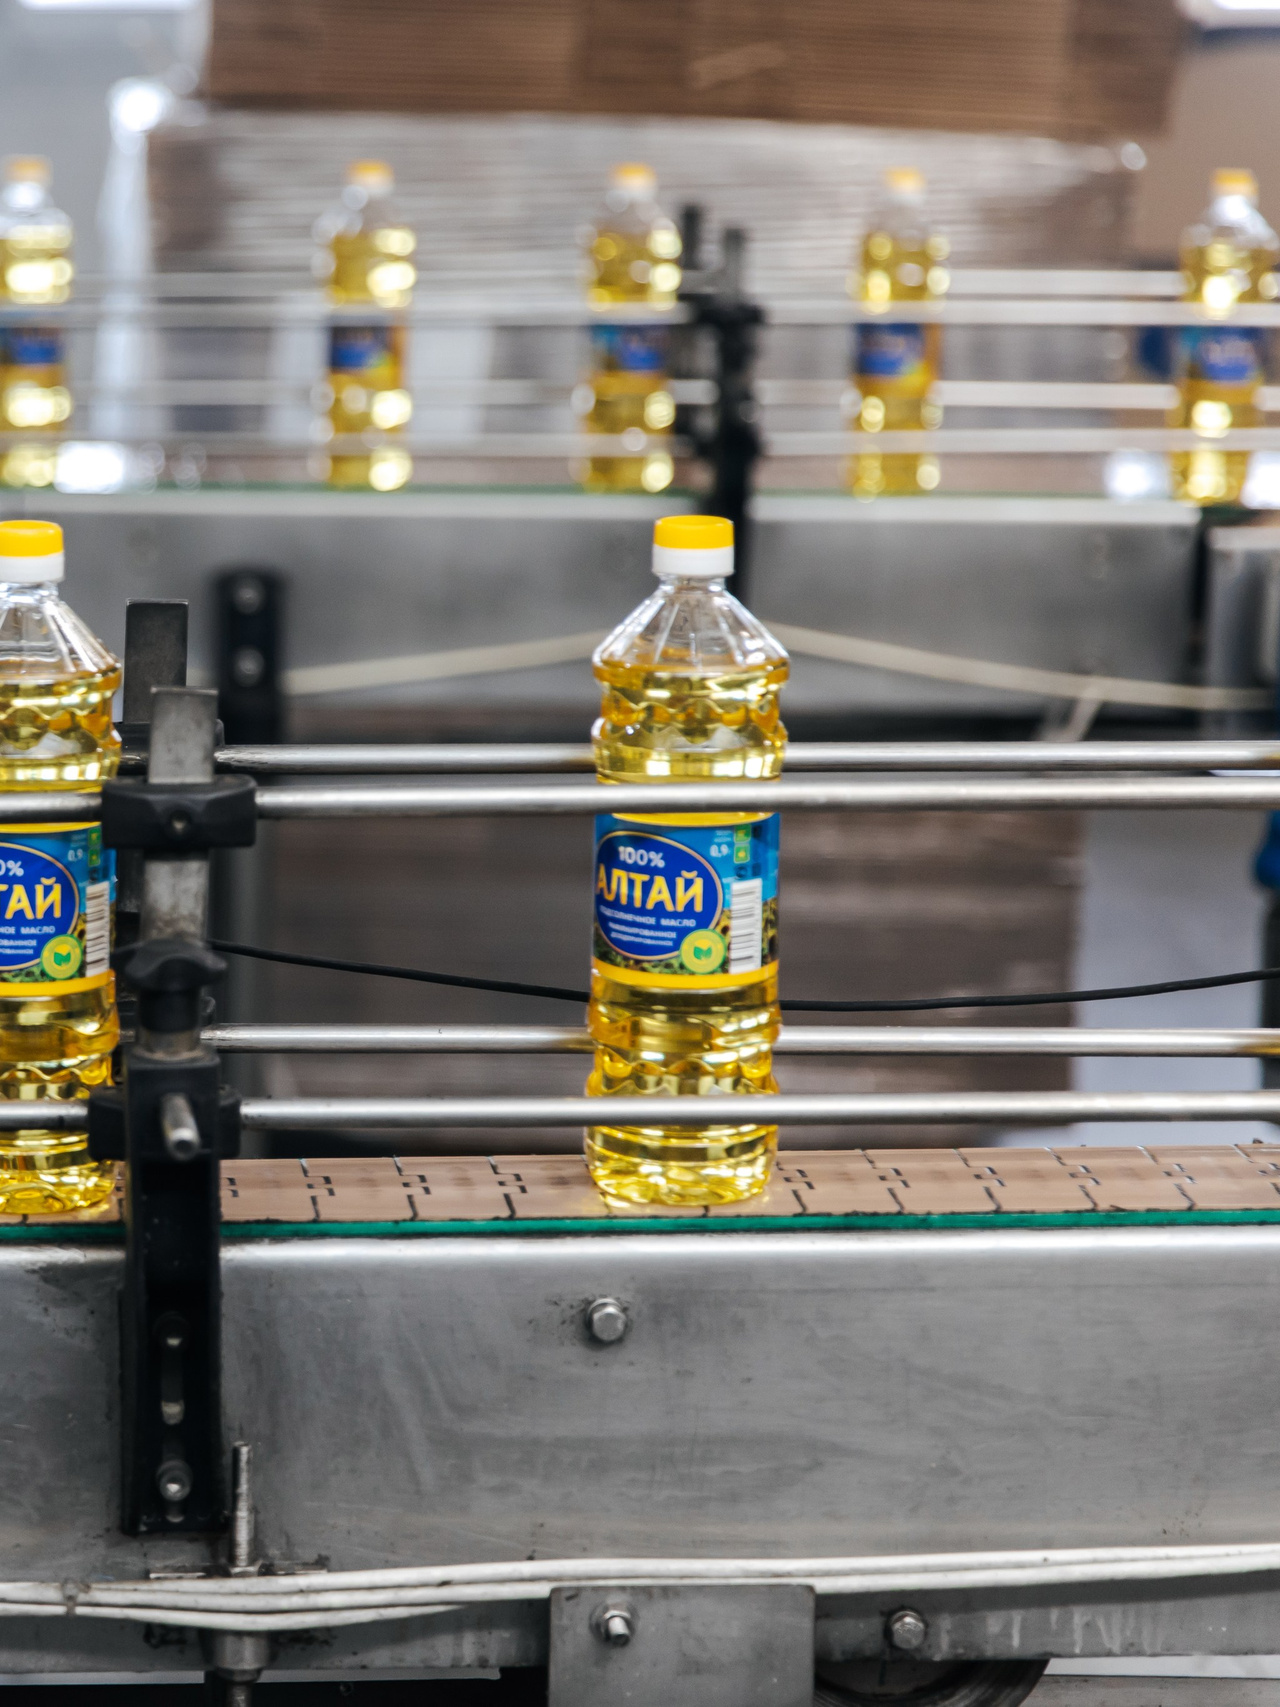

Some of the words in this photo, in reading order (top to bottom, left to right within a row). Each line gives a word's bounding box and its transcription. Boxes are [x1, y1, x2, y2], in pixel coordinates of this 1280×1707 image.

[618, 845, 666, 868] 100%
[596, 862, 704, 913] АЛТАЙ
[20, 926, 56, 934] МАСЛО
[660, 918, 697, 927] МАСЛО
